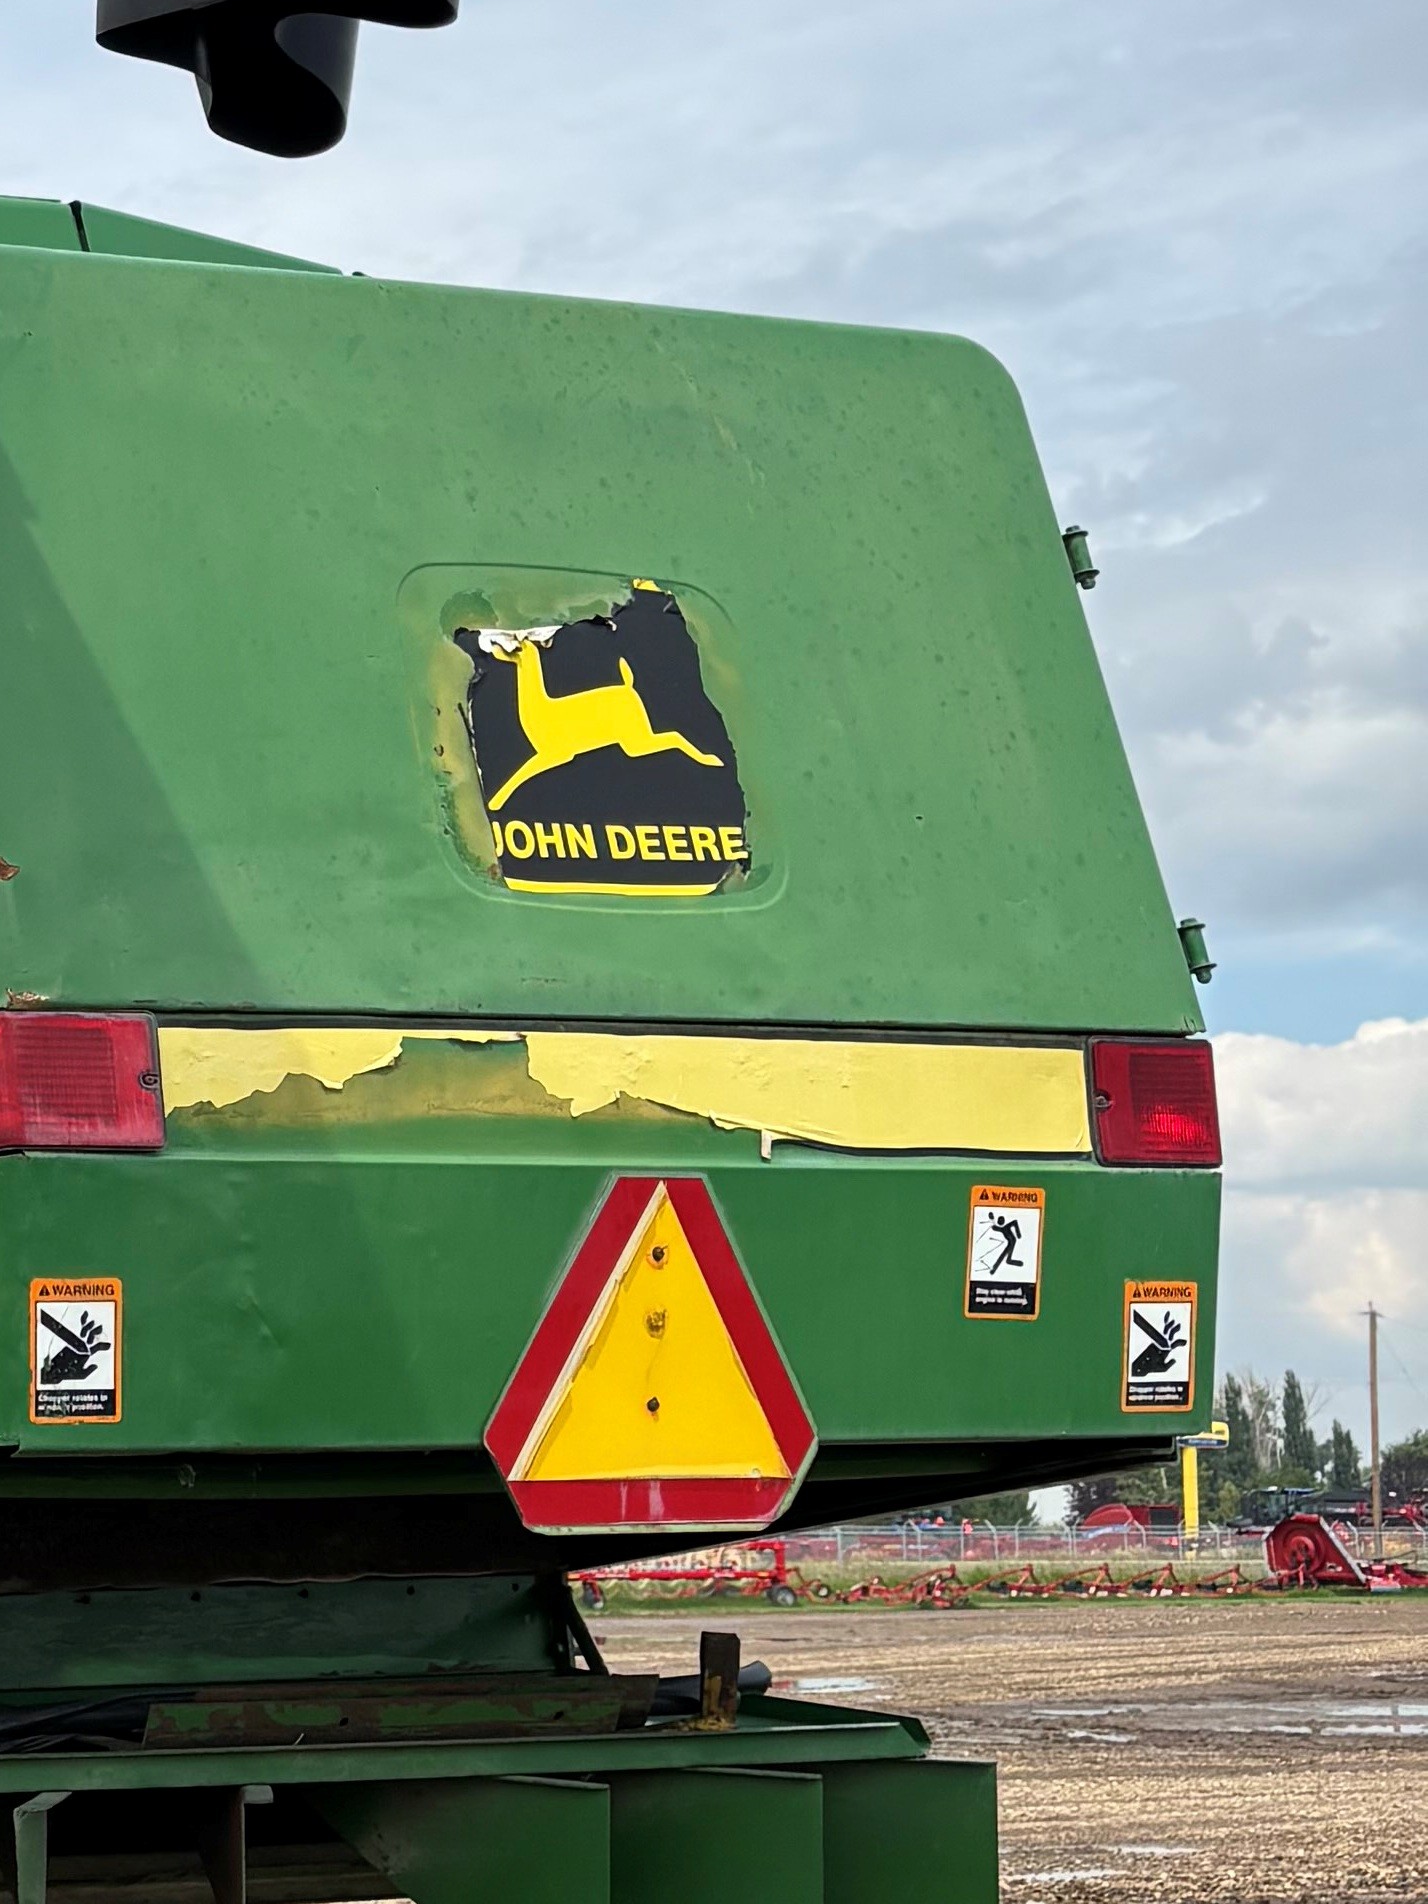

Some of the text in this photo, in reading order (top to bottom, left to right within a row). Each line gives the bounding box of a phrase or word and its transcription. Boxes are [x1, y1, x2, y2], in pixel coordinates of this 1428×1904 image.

[492, 821, 749, 861] JOHN DEERE
[52, 1284, 115, 1296] WARNING
[1143, 1287, 1191, 1297] WARNING
